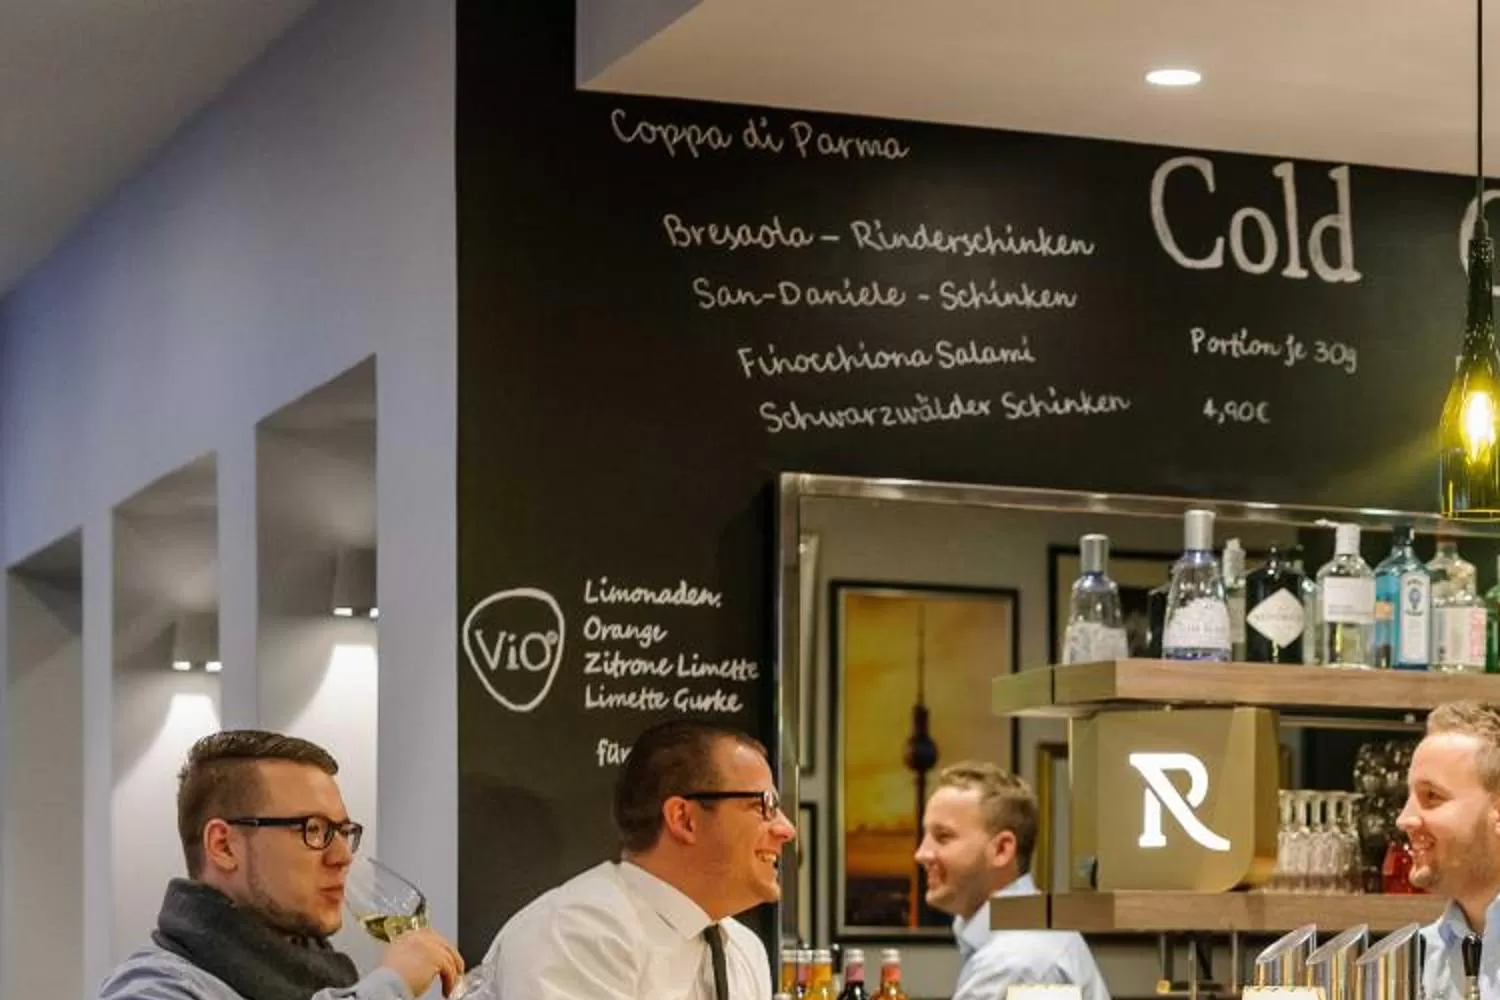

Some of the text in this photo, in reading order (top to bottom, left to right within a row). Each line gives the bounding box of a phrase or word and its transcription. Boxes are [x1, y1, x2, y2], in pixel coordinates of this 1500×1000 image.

[610, 108, 911, 160] Coppa di Parma
[662, 213, 814, 251] Bresaola
[850, 218, 1096, 257] Rinderschinken
[1148, 154, 1364, 284] Cold
[692, 276, 907, 310] San-Daniele
[938, 278, 1078, 311] Schinken
[736, 335, 1038, 380] Finocchiona Salami
[1189, 326, 1358, 375] Portion je 30g
[758, 385, 1132, 433] Schwarzwälder Schinken
[1202, 396, 1271, 425] 4,90€
[583, 615, 669, 649] Orange
[583, 650, 761, 681] Zitrone Limette
[584, 683, 744, 713] Limette Gurke
[595, 737, 633, 768] für
[1128, 752, 1232, 852] R
